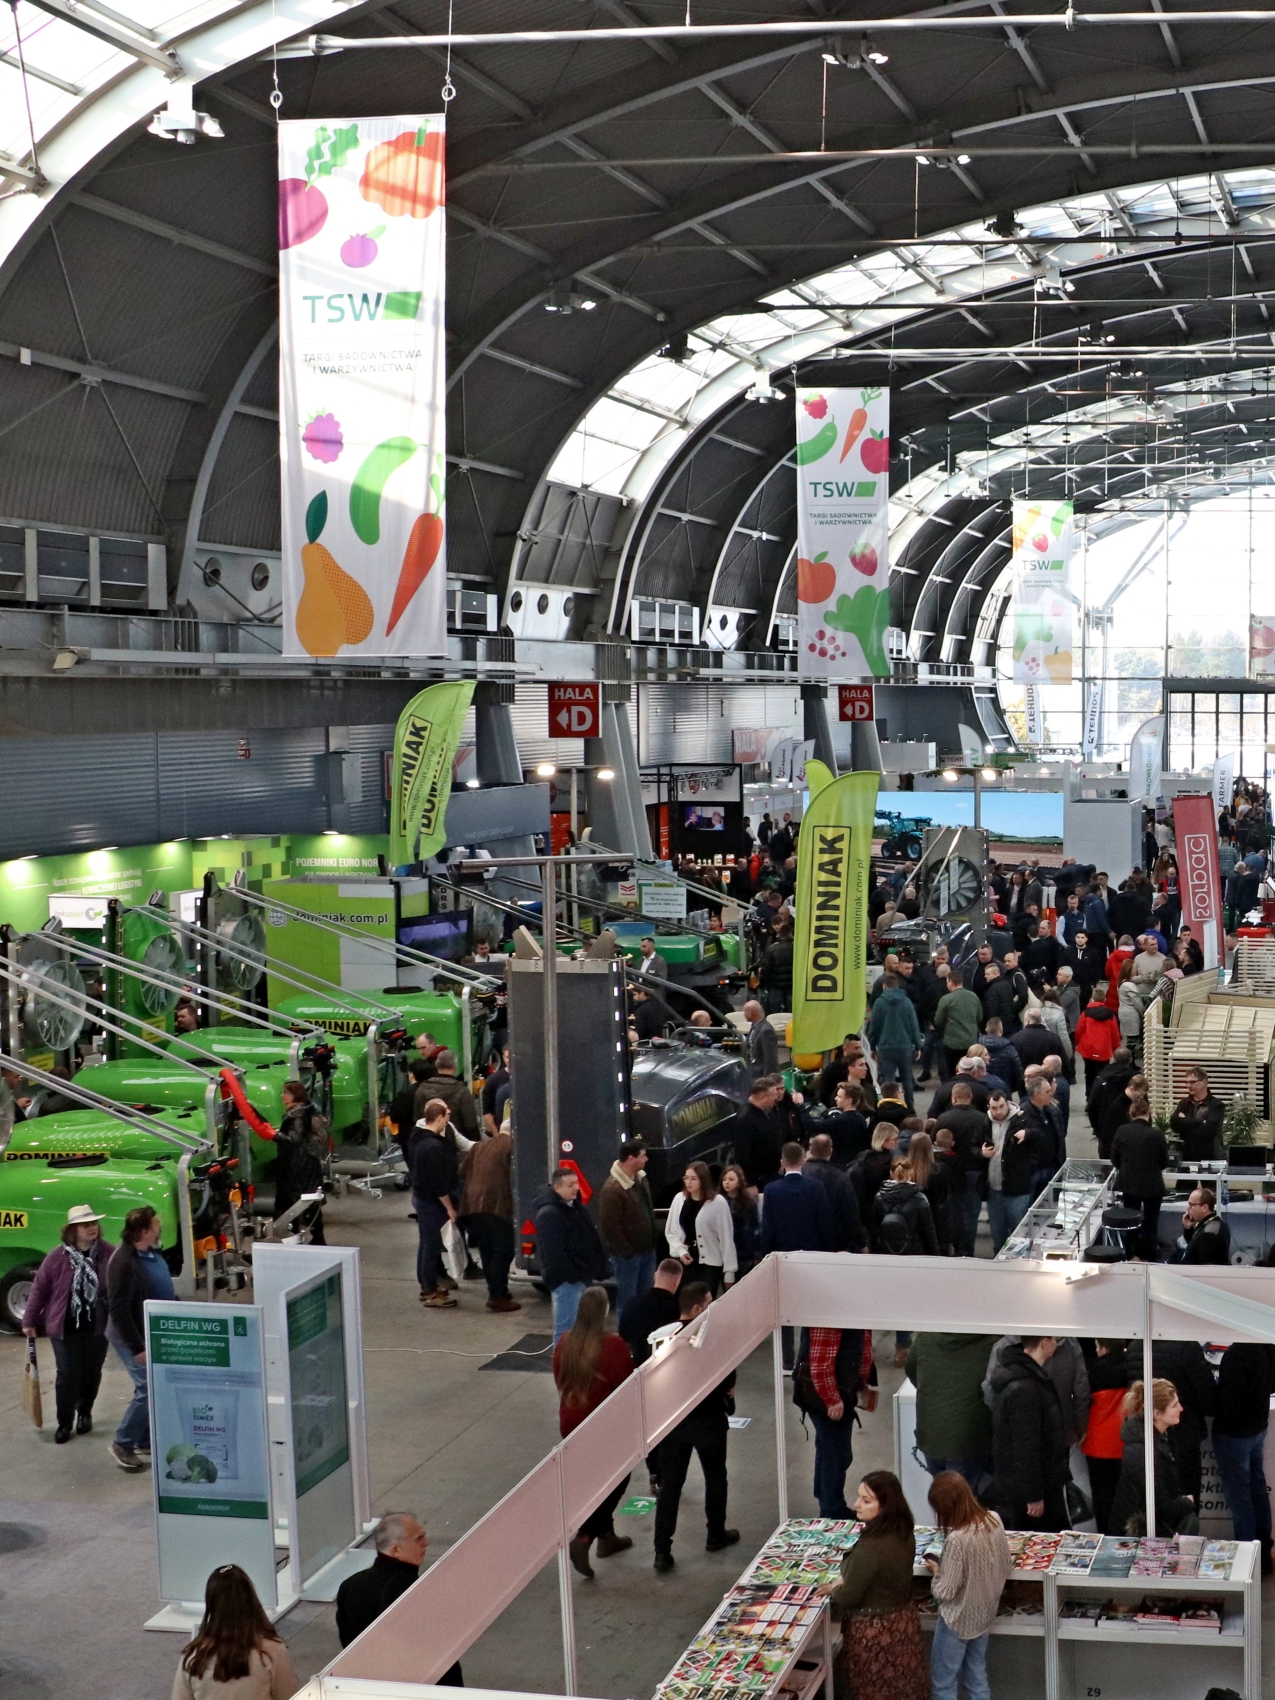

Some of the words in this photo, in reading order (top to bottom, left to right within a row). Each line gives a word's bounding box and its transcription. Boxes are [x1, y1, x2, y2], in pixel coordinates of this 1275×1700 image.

[302, 292, 382, 323] TSW
[302, 353, 335, 362] TARGI
[338, 350, 422, 361] SADOWNICTWA
[319, 363, 413, 374] WARZYWNICTWA
[809, 481, 855, 498] TSW
[1022, 560, 1050, 570] TSW
[555, 688, 593, 700] HALA
[842, 688, 869, 699] HALA
[855, 701, 869, 719] D
[571, 705, 593, 731] D
[1218, 770, 1226, 808] FARMER
[296, 858, 337, 867] POJEMNIKI
[339, 858, 360, 867] EURO
[362, 858, 378, 867] NOR
[811, 833, 845, 993] DOMINIAK
[853, 859, 865, 970] www.dominiak.com.pl
[160, 1320, 199, 1330] DELFIN
[202, 1322, 220, 1331] WG
[160, 1338, 197, 1346] Biologiczna
[192, 1407, 207, 1415] BIO
